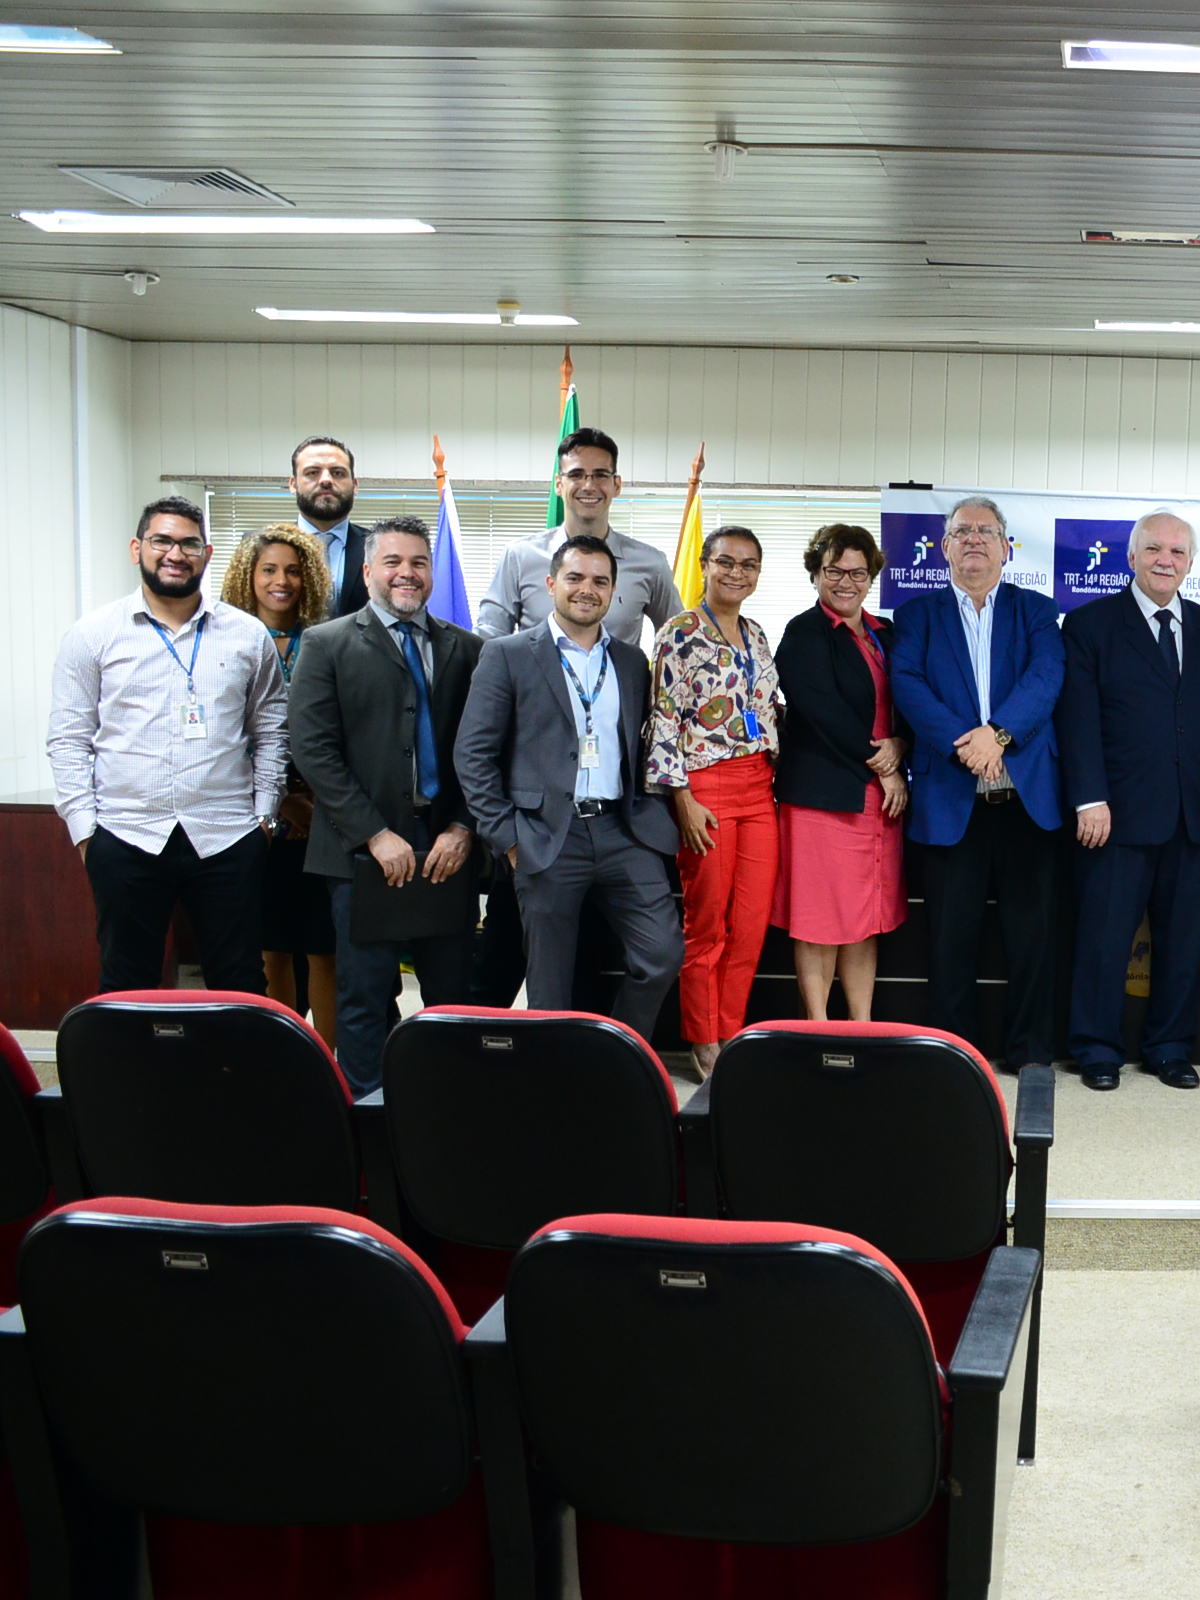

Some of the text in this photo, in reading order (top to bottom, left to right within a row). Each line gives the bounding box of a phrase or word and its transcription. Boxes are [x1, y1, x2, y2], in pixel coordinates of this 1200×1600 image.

[889, 568, 951, 581] TRT-14ª REGIÃ
[1014, 571, 1047, 585] REGIÃO
[1064, 573, 1130, 586] TRT-14ª REGIÃO
